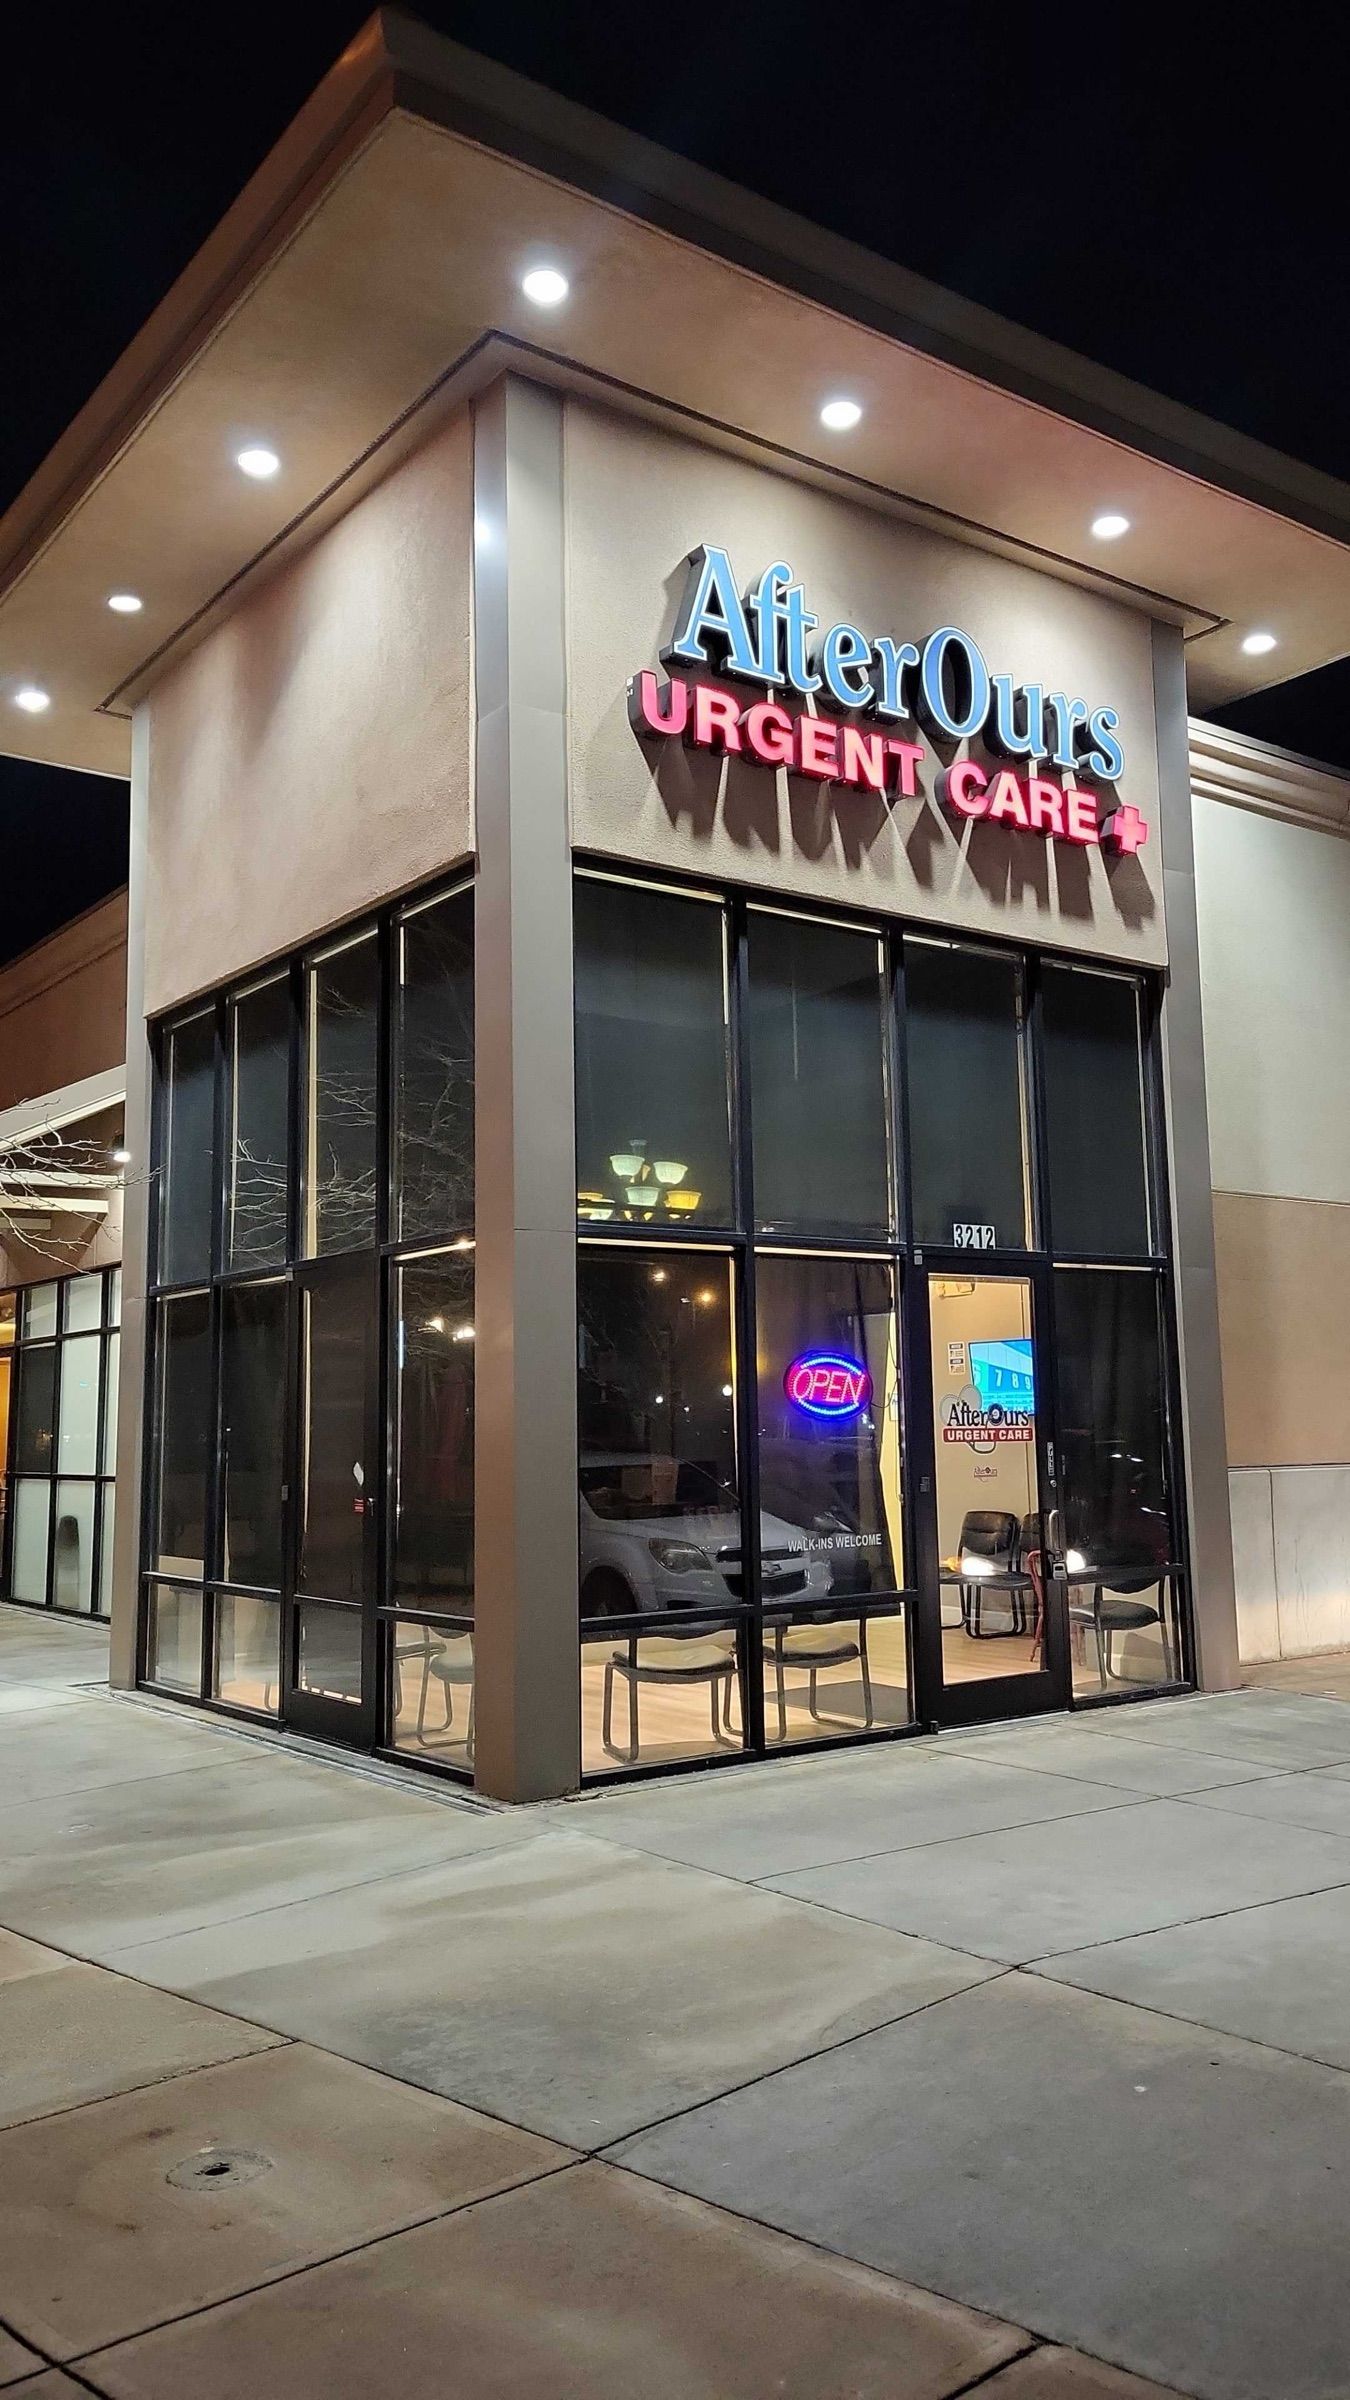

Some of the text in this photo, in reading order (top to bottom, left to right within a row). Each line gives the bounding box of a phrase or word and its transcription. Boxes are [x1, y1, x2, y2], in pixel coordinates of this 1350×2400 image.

[673, 543, 1125, 782] AfterOurs
[638, 669, 1101, 846] URGENT CARE
[954, 1224, 995, 1248] 3212
[793, 1369, 865, 1406] OPEN
[995, 1368, 1003, 1387] 7
[1011, 1372, 1019, 1388] 8
[947, 1428, 1030, 1441] URGENT CARE
[787, 1534, 882, 1552] WALK-INS WELCOME
